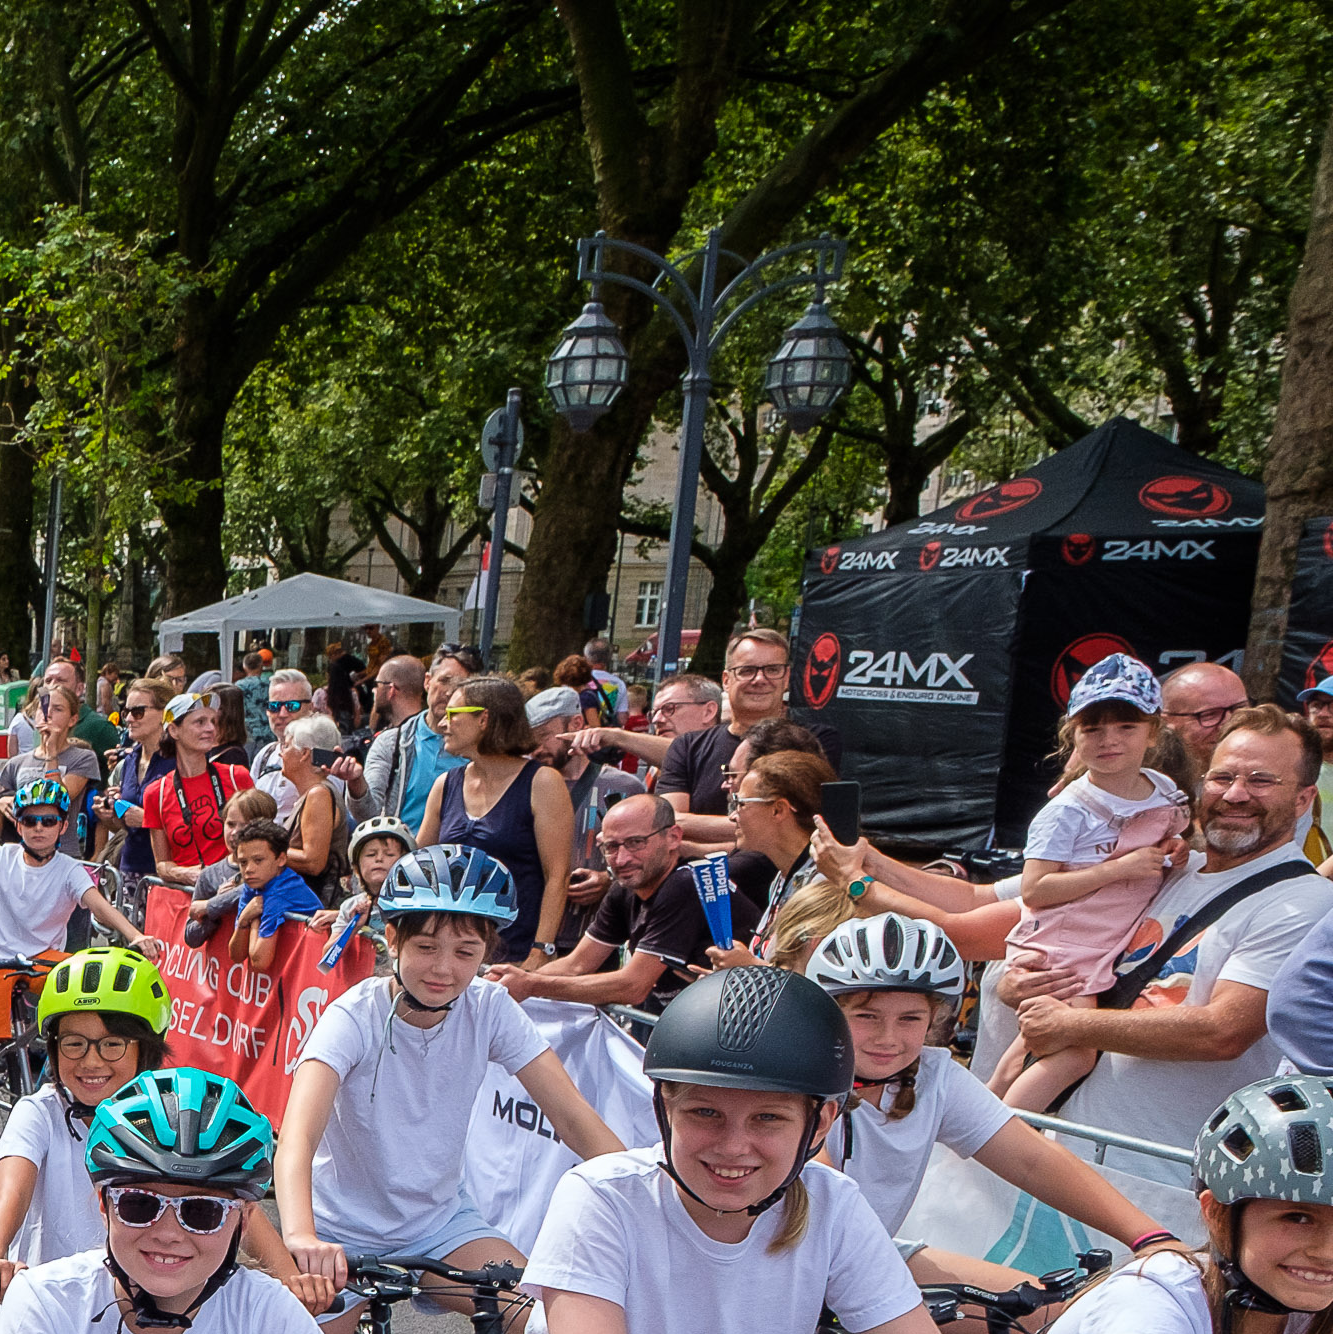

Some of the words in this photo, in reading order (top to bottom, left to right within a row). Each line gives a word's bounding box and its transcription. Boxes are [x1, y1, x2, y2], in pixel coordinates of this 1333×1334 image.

[838, 551, 900, 571] 24MX
[940, 546, 1011, 571] 24MX
[1102, 541, 1216, 561] 24MX
[844, 650, 974, 689] 24MX
[841, 687, 888, 698] MOTOCROSS
[896, 690, 934, 700] ENDURO
[936, 692, 973, 702] ONLINE
[700, 866, 717, 904] YIPPIE
[714, 857, 729, 897] YIPPIE
[168, 996, 266, 1060] SELDORF
[710, 1059, 754, 1071] FOUGANZA
[492, 1089, 560, 1145] MOL
